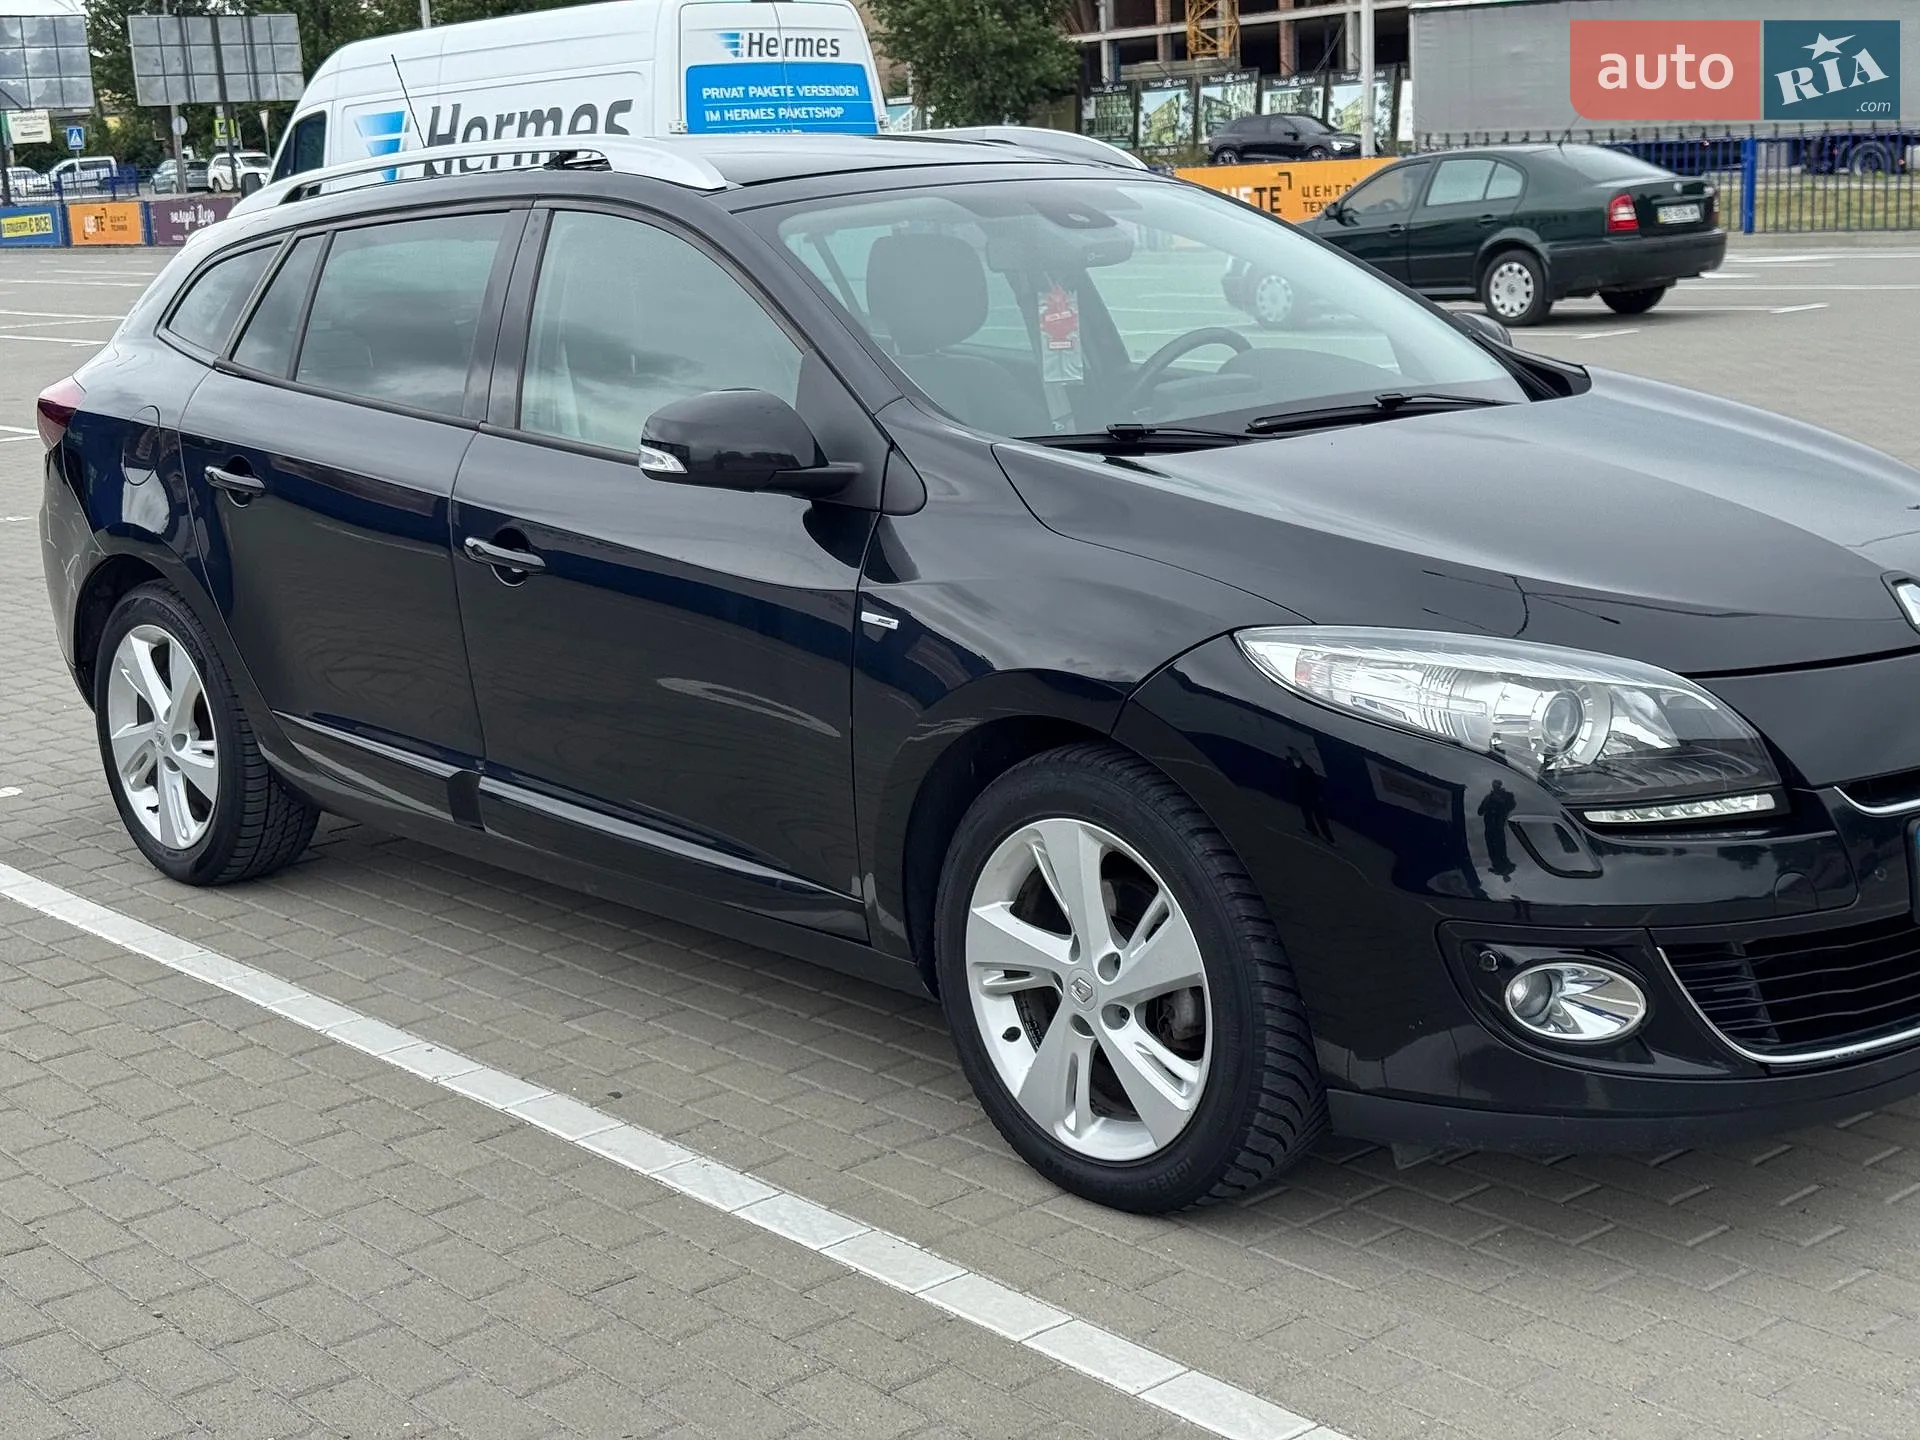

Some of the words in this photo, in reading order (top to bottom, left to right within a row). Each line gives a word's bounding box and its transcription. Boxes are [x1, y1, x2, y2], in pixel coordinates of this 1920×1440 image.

[748, 32, 840, 58] Hermes
[702, 86, 745, 99] PRIVAT
[749, 85, 795, 98] PAKETE
[799, 85, 860, 97] VERSENDEN
[705, 110, 721, 122] IM
[725, 108, 776, 121] HERMES
[778, 106, 845, 120] PAKETSHOP
[424, 99, 634, 176] Hermes
